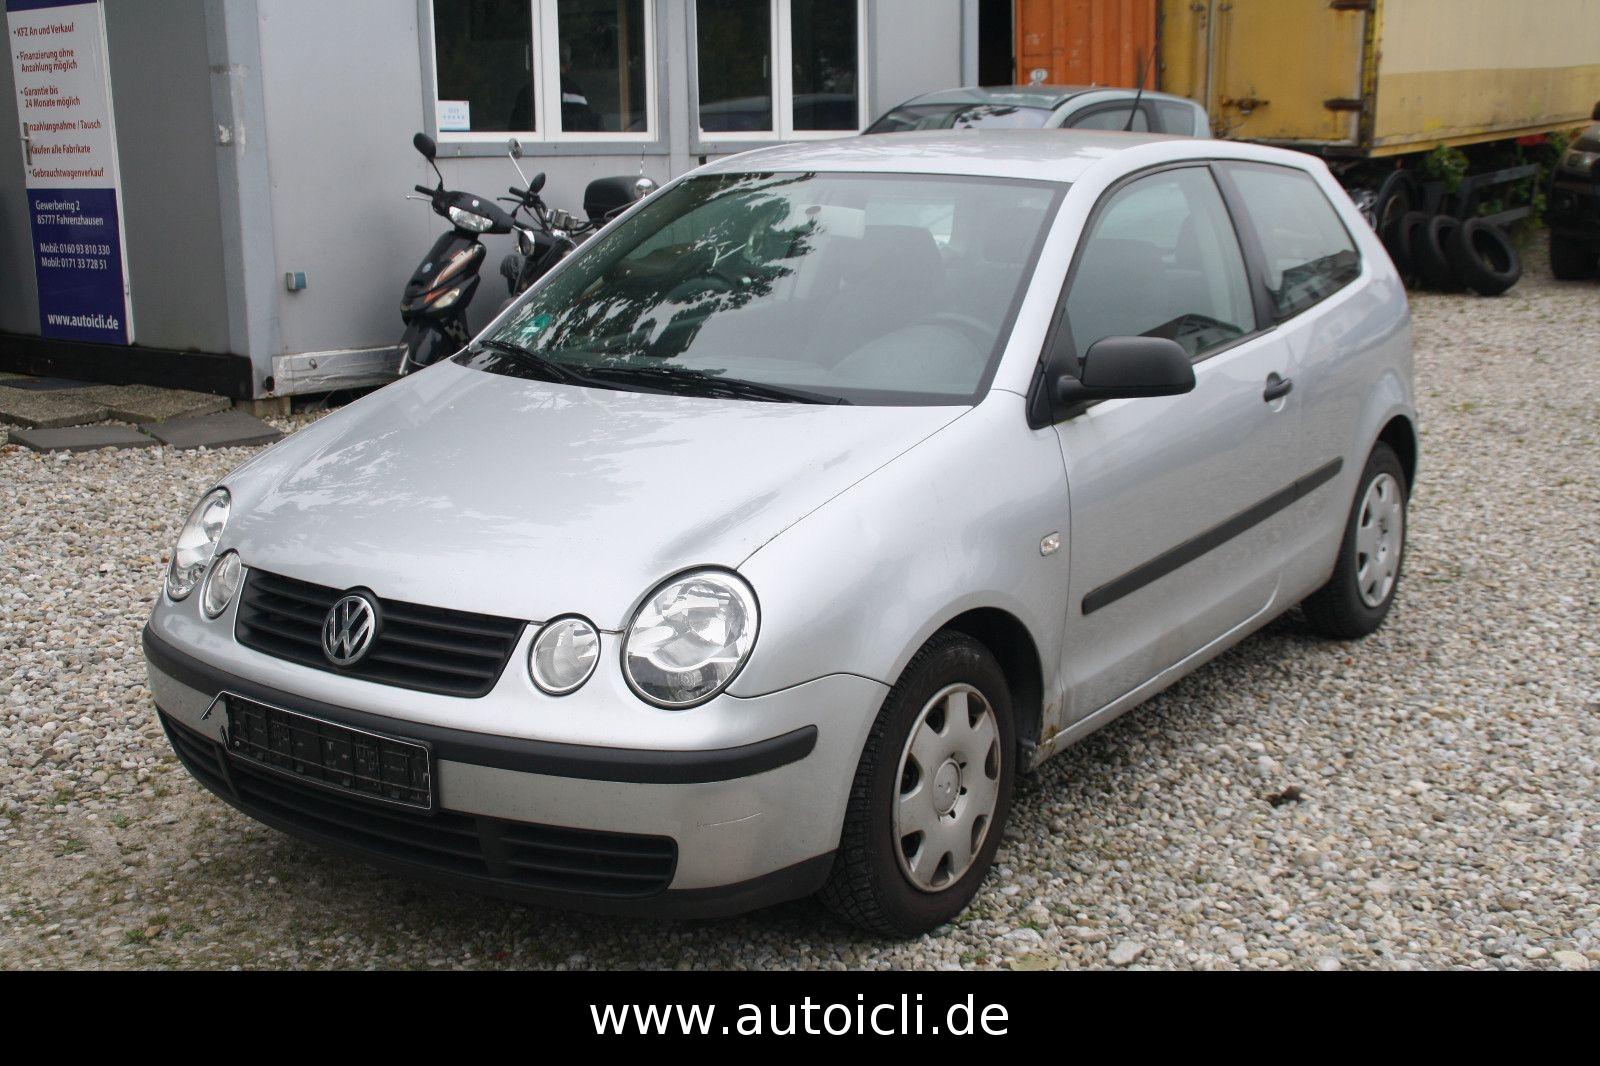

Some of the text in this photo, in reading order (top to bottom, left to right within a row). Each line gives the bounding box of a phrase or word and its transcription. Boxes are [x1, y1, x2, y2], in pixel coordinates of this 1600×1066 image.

[17, 22, 74, 37] KFZ An und Verkauf
[20, 48, 74, 61] Finanzierung ohne
[21, 60, 78, 73] Anzahlung möglich
[24, 86, 59, 97] Garantie bis
[25, 96, 81, 108] 24 Monate möglich
[26, 121, 76, 132] nzahlungnahme
[80, 119, 100, 129] Tausch
[51, 144, 62, 154] alle
[62, 144, 91, 154] Fabrikate
[32, 167, 104, 179] Gebrauchtwagenverkauf
[35, 200, 80, 213] Gewerbering 2
[56, 215, 103, 225] Fahrenzhausen
[40, 242, 110, 255] Mobil: 0160 93 810 330
[41, 256, 107, 270] Mobil: 0171 33 728 51
[47, 313, 119, 330] www.autoicli.de
